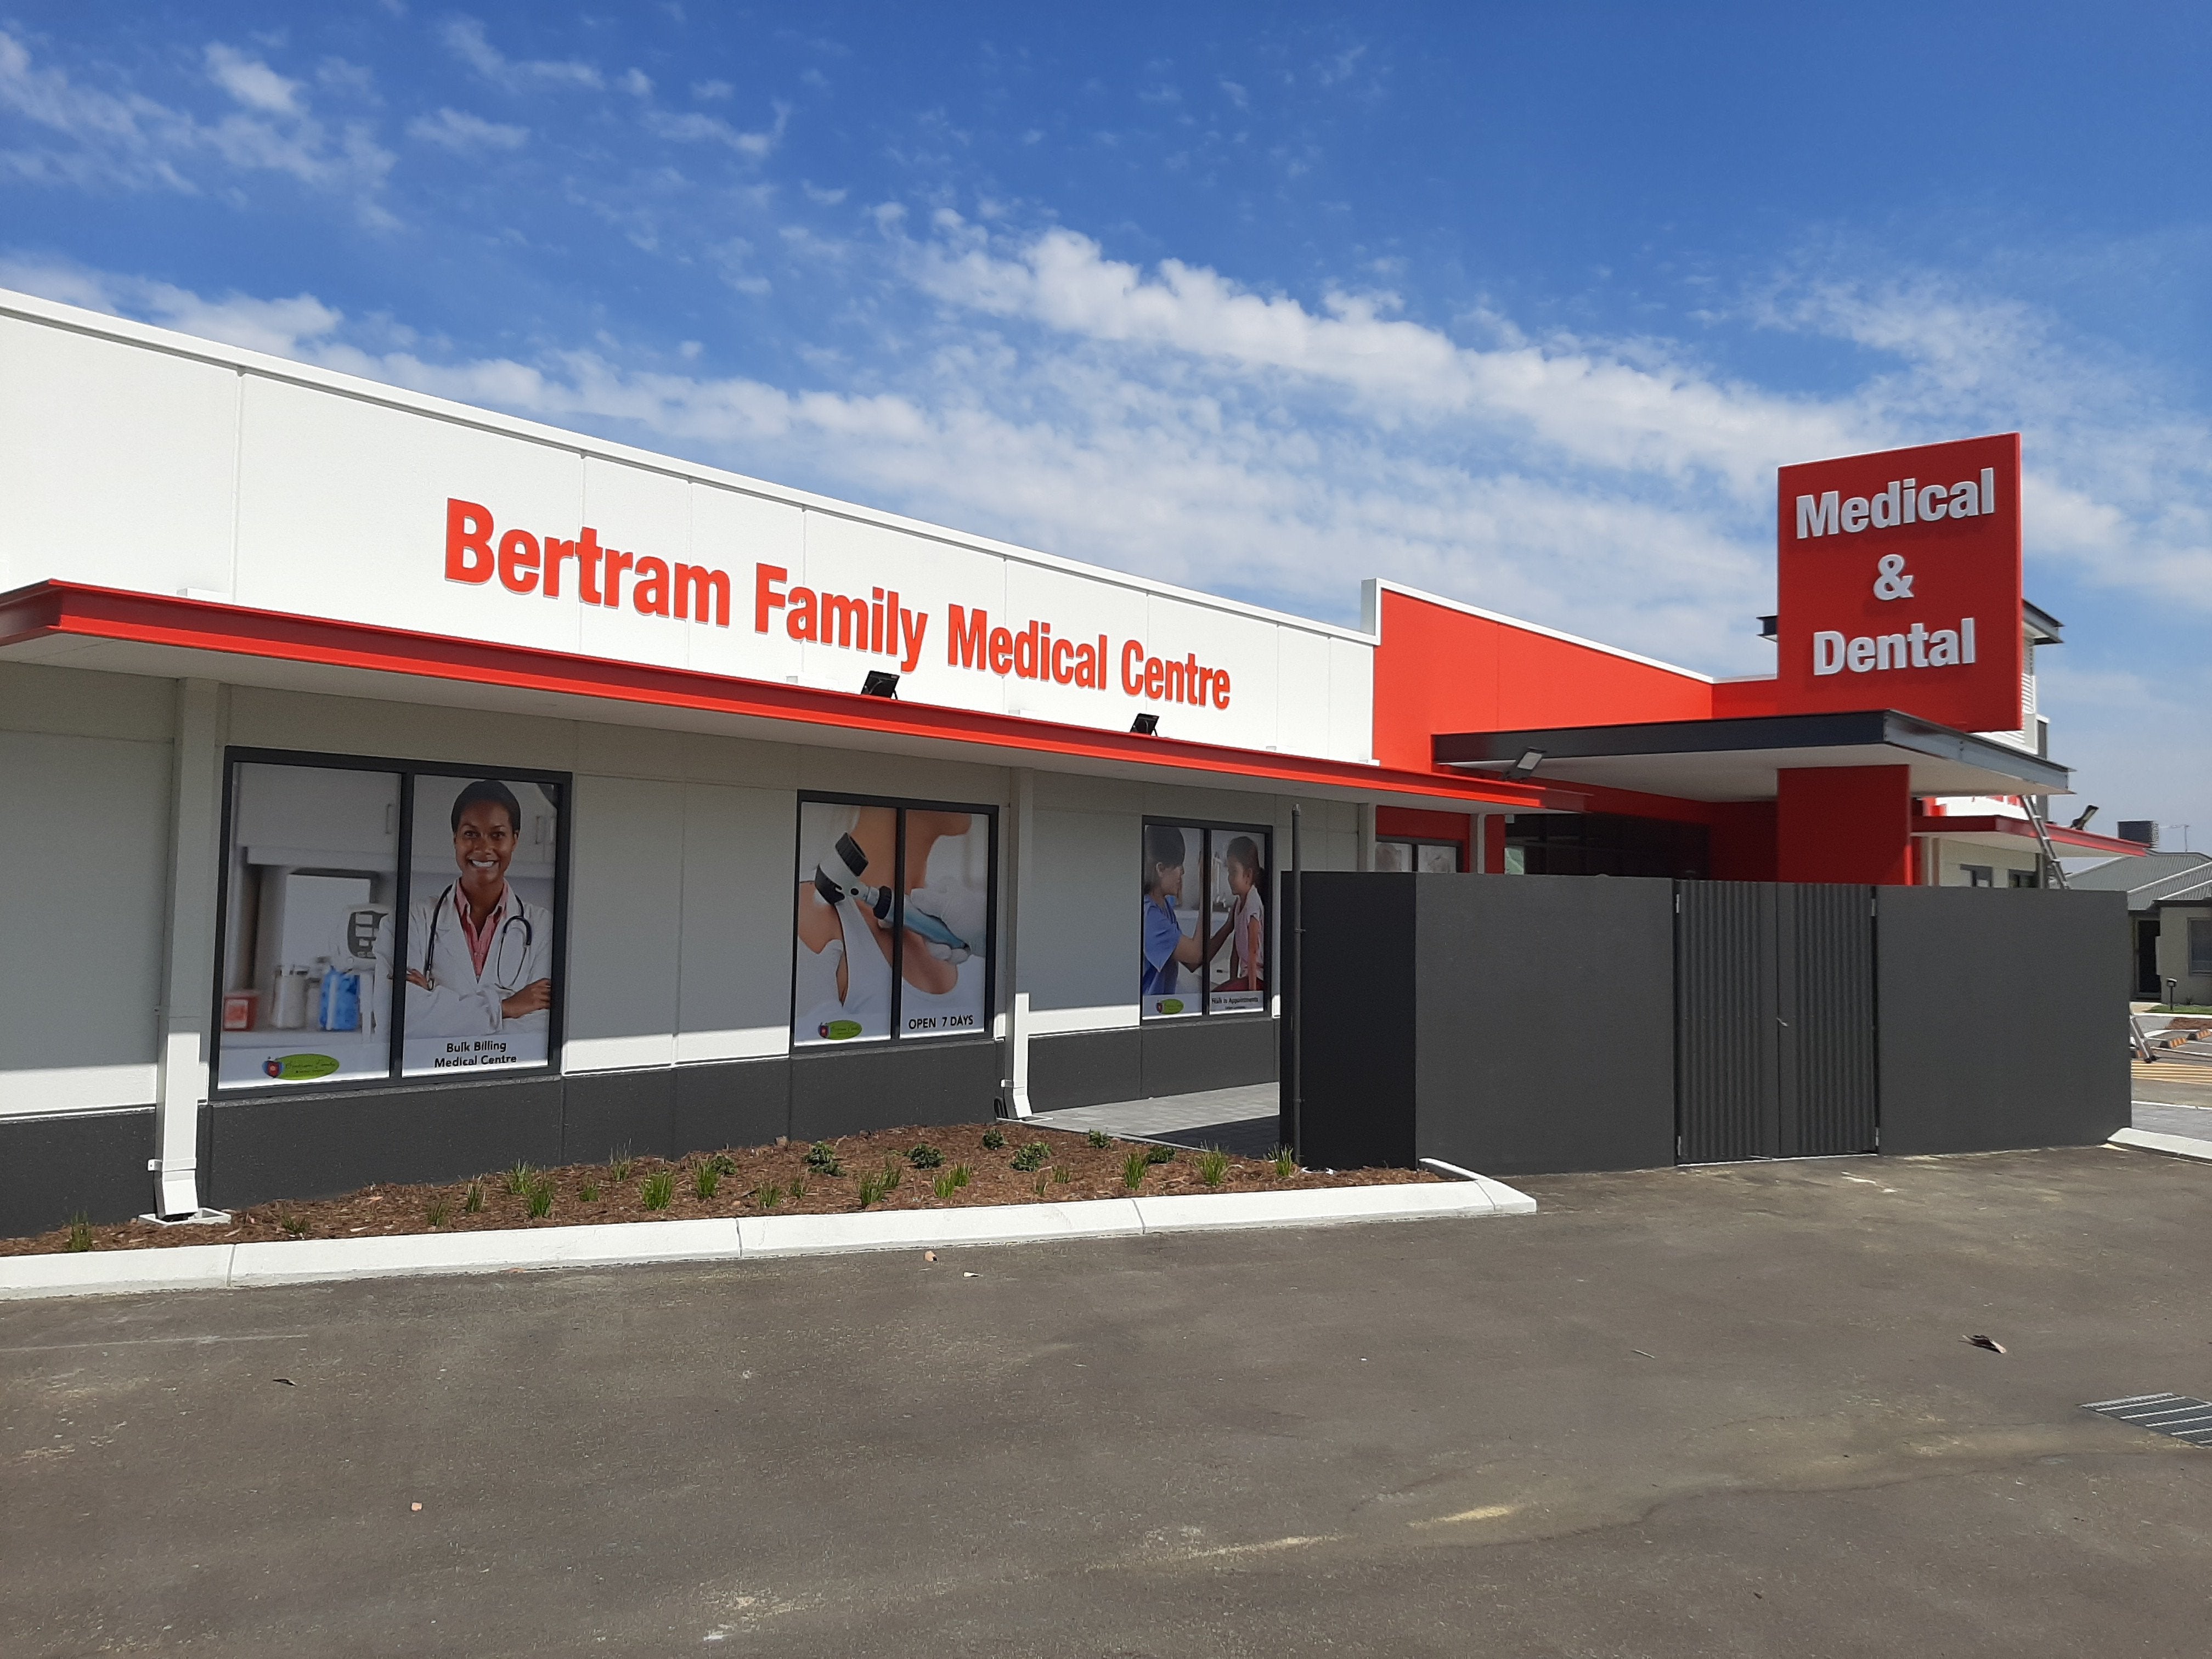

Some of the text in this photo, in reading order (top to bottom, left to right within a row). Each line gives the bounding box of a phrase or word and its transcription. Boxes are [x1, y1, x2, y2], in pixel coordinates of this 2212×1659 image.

[1796, 467, 1995, 539] Medical
[1872, 554, 1915, 601] &
[447, 498, 1231, 710] Bertram Family Medical Centre
[1813, 617, 1976, 676] Dental
[909, 1015, 973, 1029] OPEN 7 DAYS
[435, 1056, 517, 1068] Medical Centre
[447, 1041, 506, 1053] Bulk Billing
